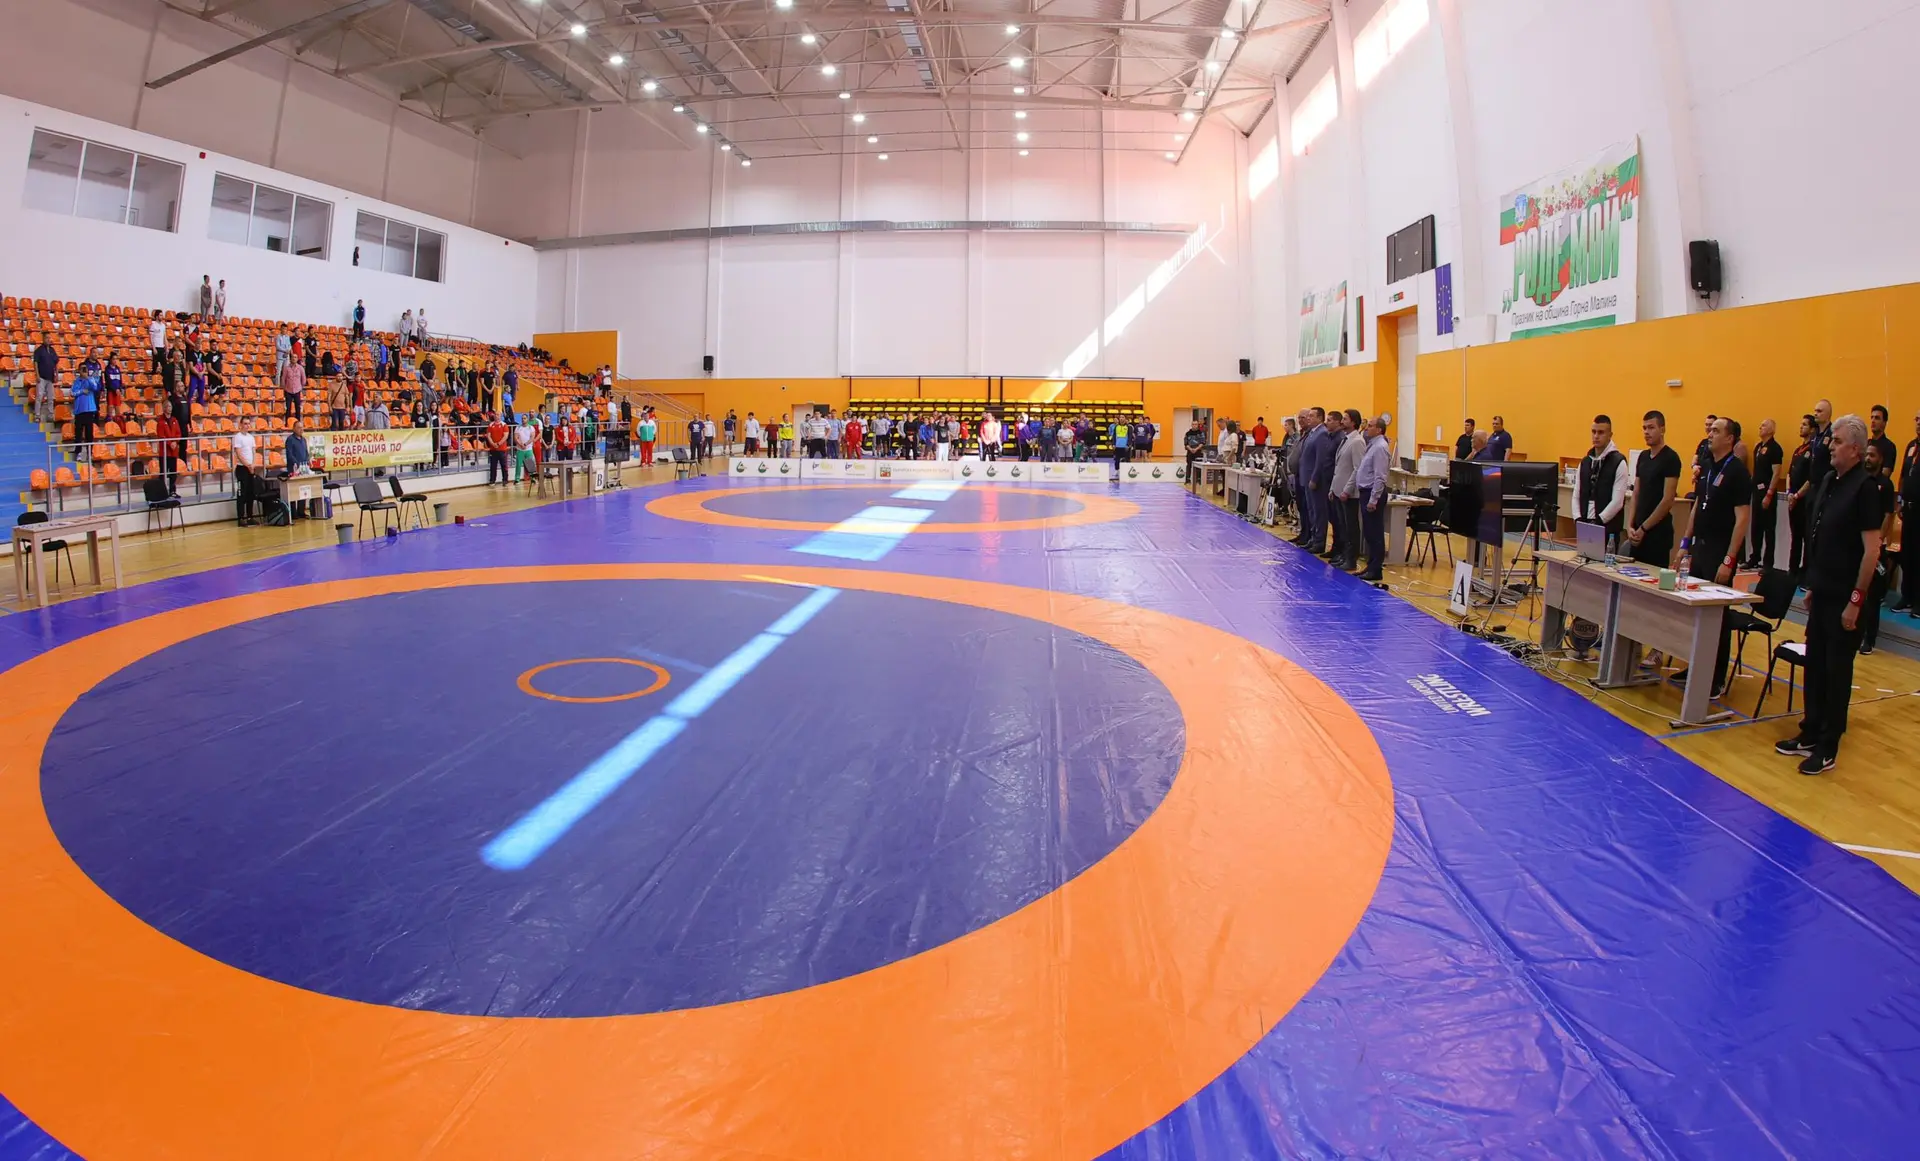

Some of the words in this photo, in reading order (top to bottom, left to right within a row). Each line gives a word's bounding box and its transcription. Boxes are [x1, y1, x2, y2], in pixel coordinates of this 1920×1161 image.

[1511, 312, 1534, 326] Празник
[1536, 311, 1543, 321] на
[1544, 305, 1569, 320] община
[1570, 300, 1589, 318] Горна
[1590, 294, 1617, 311] Малина
[332, 433, 385, 444] БЪЛГАРСКА
[332, 443, 387, 456] ФЕДЕРАЦИЯ
[390, 443, 402, 452] ПО
[333, 456, 364, 467] БОРБА
[597, 474, 603, 486] B
[1267, 502, 1273, 519] B
[1453, 574, 1465, 606] A
[1417, 674, 1492, 716] WRESTLING
